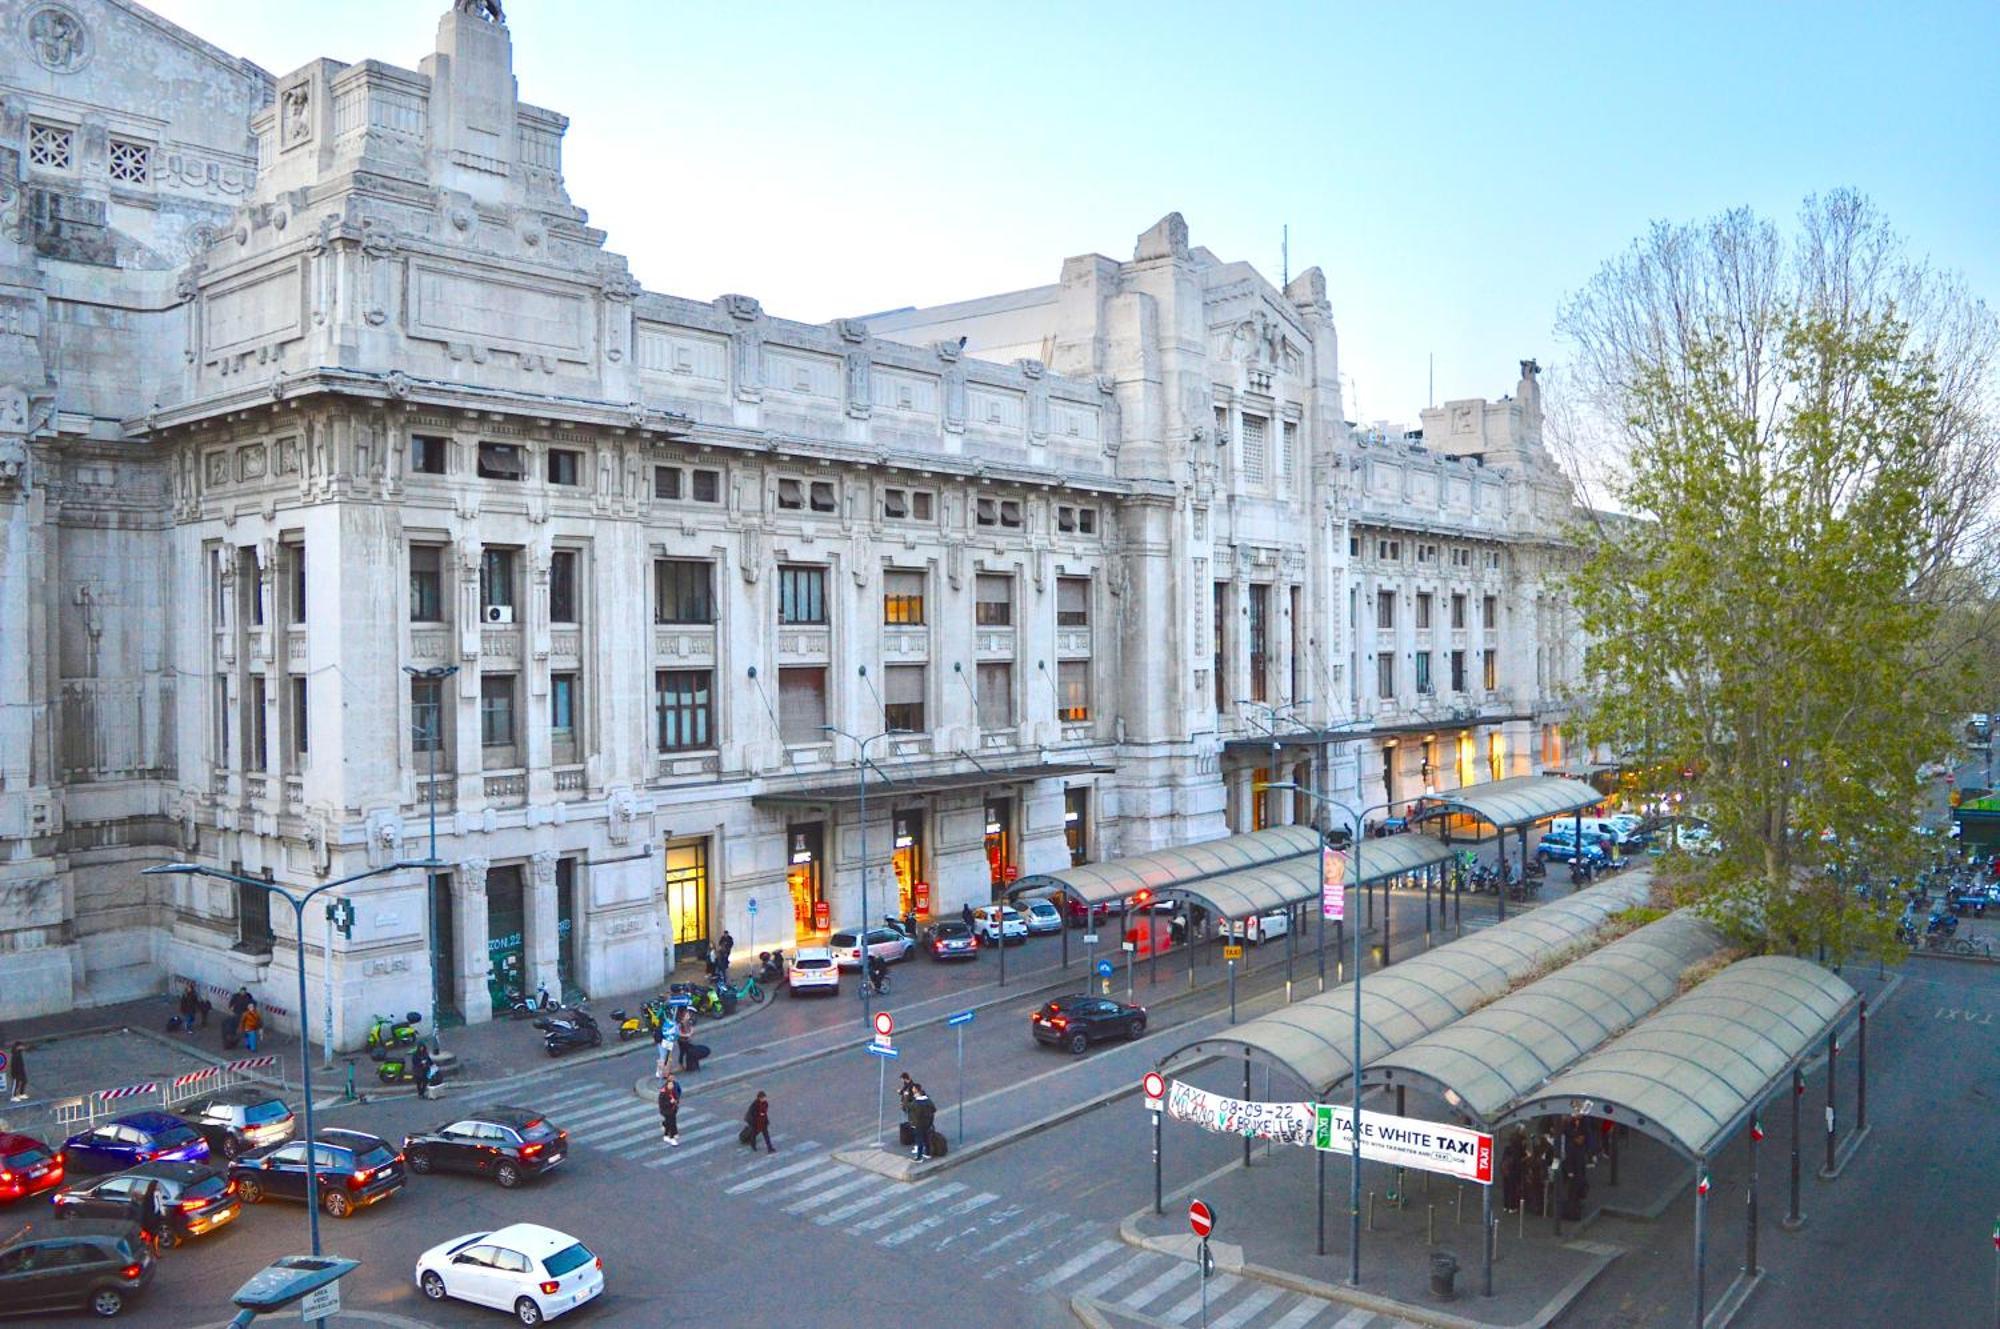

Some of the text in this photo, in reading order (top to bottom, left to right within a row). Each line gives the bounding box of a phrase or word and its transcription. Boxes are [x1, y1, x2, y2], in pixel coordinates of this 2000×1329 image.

[1237, 1116, 1303, 1133] BRUXELLES
[1318, 1117, 1329, 1138] TAXI
[1379, 1126, 1431, 1148] WHITE
[1436, 1136, 1475, 1156] TAXI
[1479, 1147, 1489, 1170] TAXI
